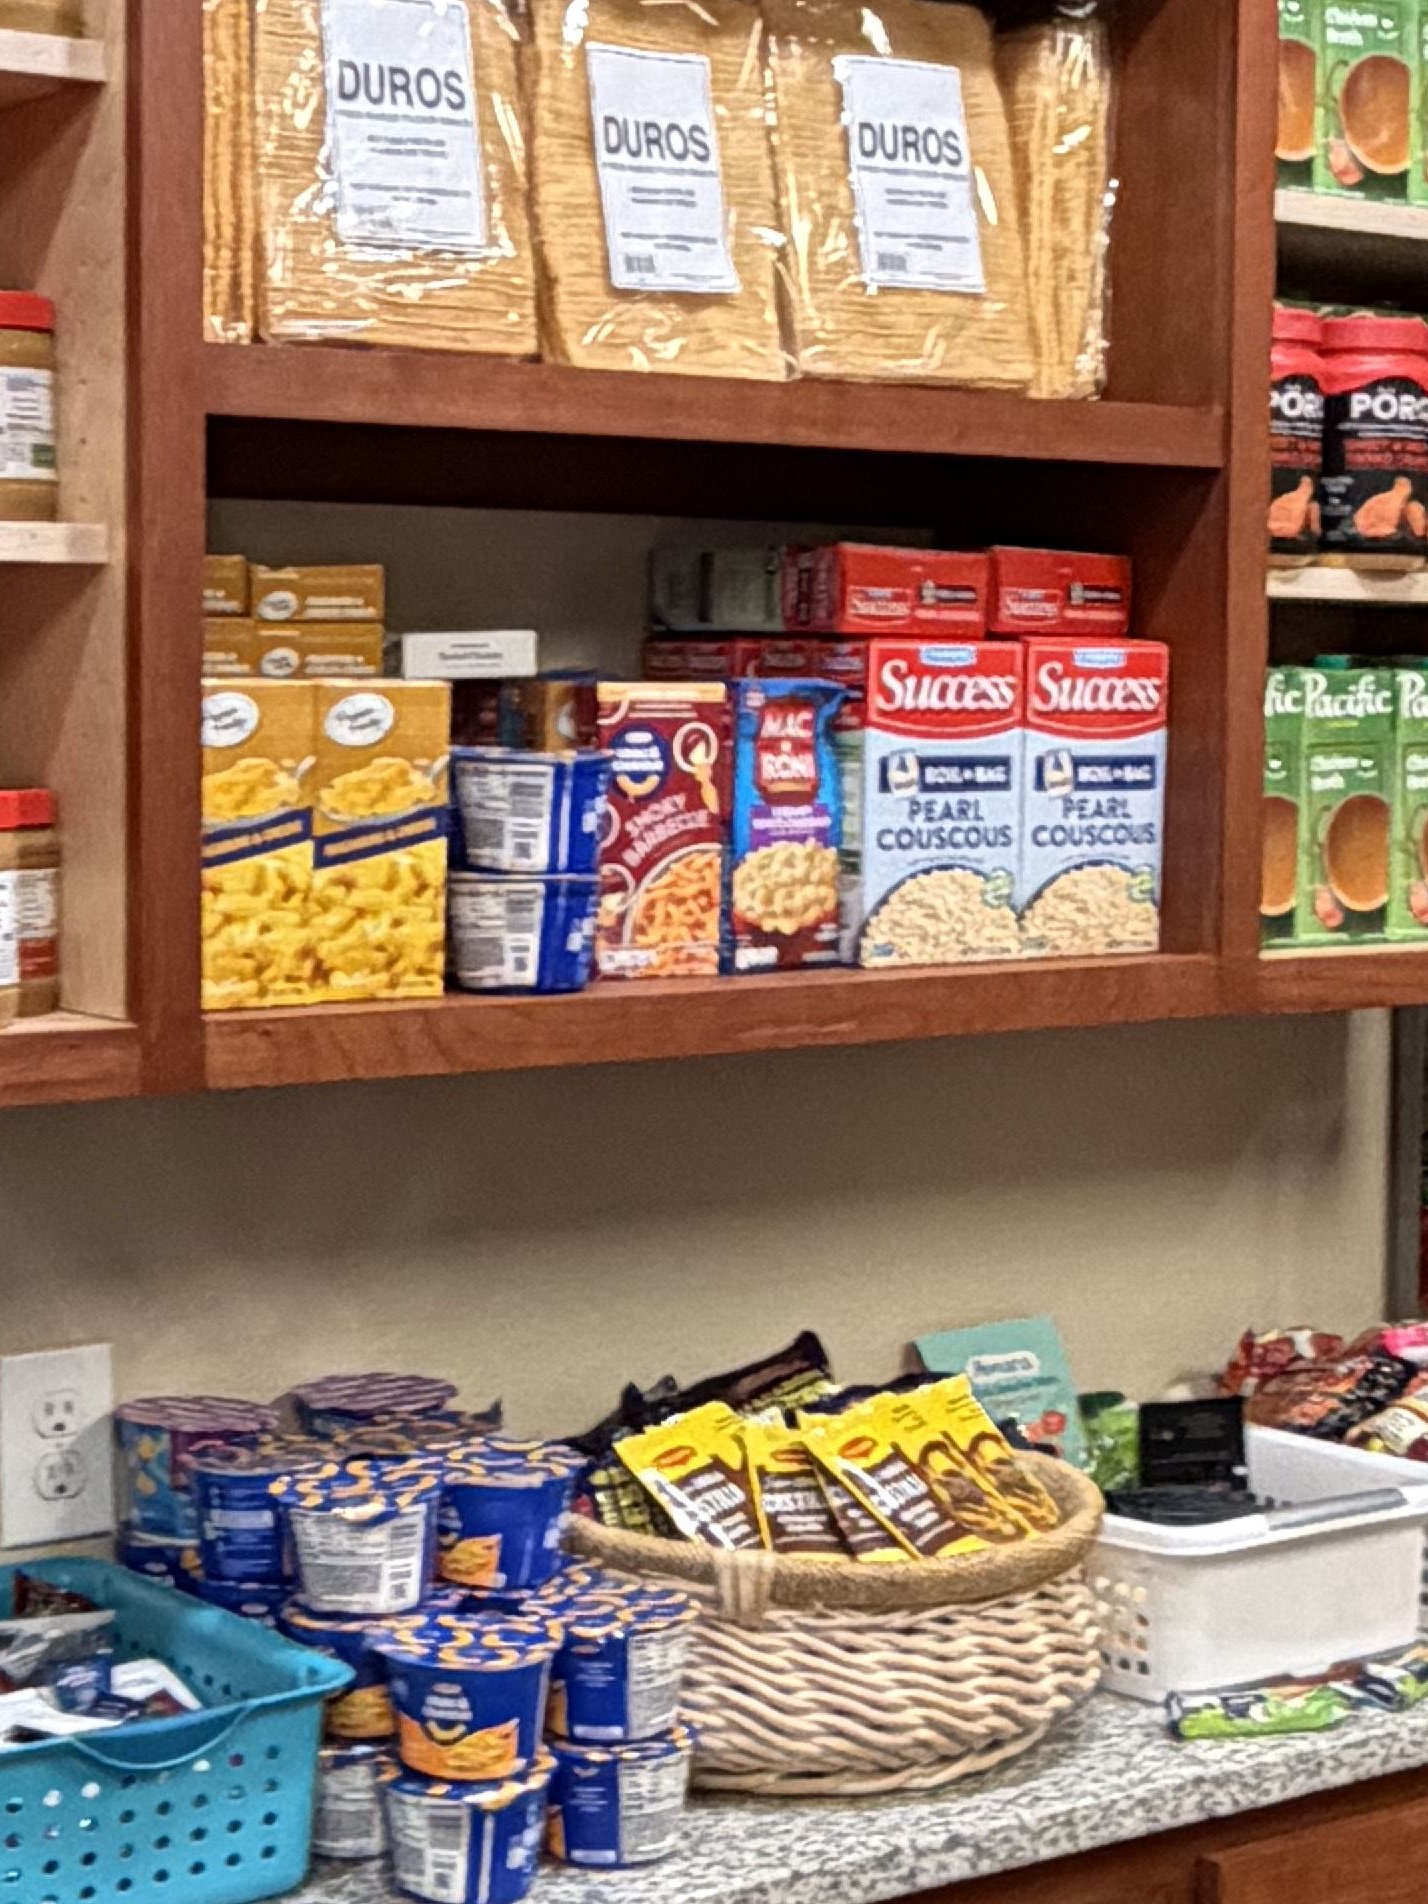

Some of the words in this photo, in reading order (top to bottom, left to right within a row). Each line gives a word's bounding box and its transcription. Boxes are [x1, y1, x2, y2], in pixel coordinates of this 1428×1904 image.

[336, 57, 468, 112] DUROS
[602, 114, 712, 165] DUROS
[856, 120, 965, 169] DUROS
[876, 658, 1018, 711] Success
[1031, 660, 1163, 712] Success
[1302, 672, 1394, 718] Pacific
[908, 797, 985, 822] PEARL
[1062, 796, 1132, 820] PEARL
[876, 824, 1013, 852] COUSCOUS
[1031, 822, 1156, 848] COUSCOUS
